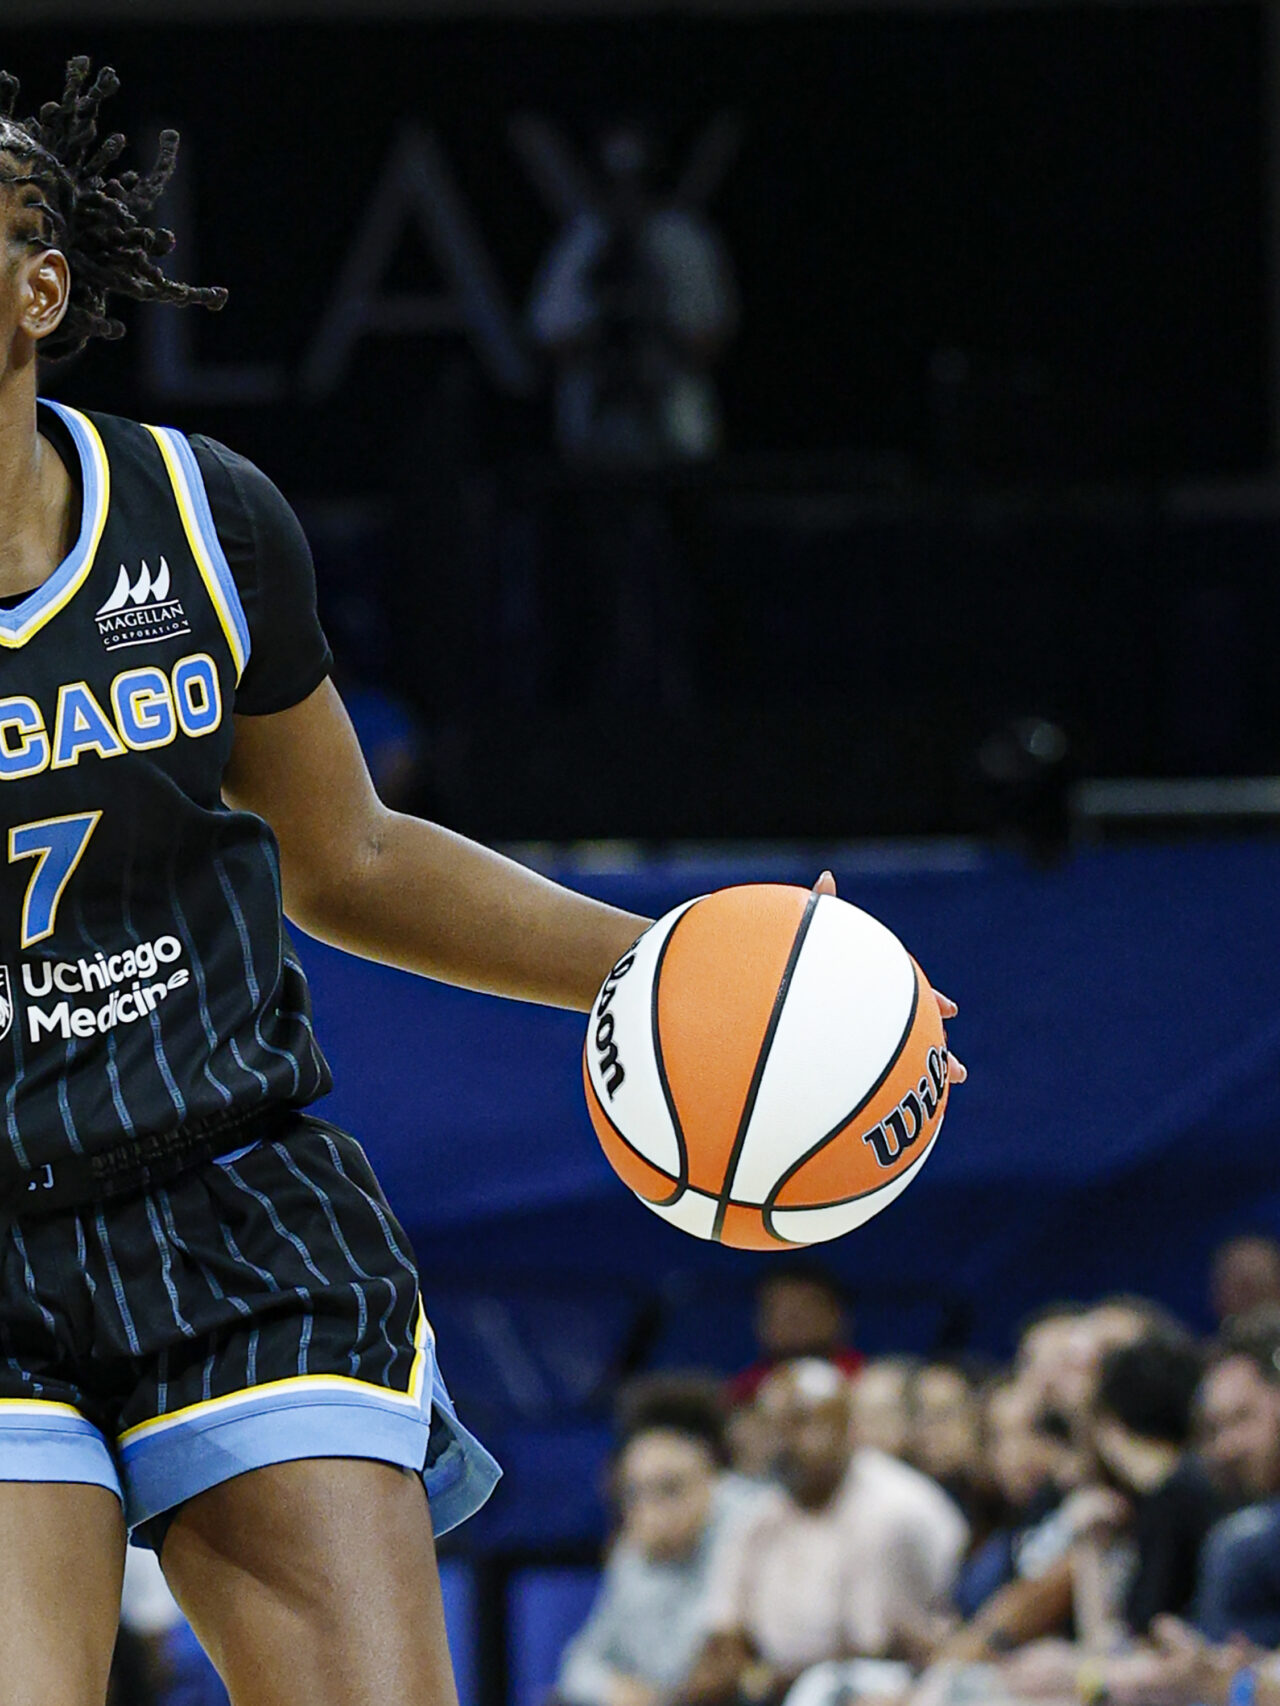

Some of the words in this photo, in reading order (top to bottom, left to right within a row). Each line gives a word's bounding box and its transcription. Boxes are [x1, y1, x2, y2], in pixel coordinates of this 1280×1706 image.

[97, 603, 184, 635] MAGELLAN
[103, 620, 190, 645] CORPORATION
[8, 809, 104, 950] 7
[21, 935, 182, 997] UChicago
[26, 968, 191, 1043] Medicine
[595, 938, 641, 1103] lson
[862, 1045, 948, 1168] Wil
